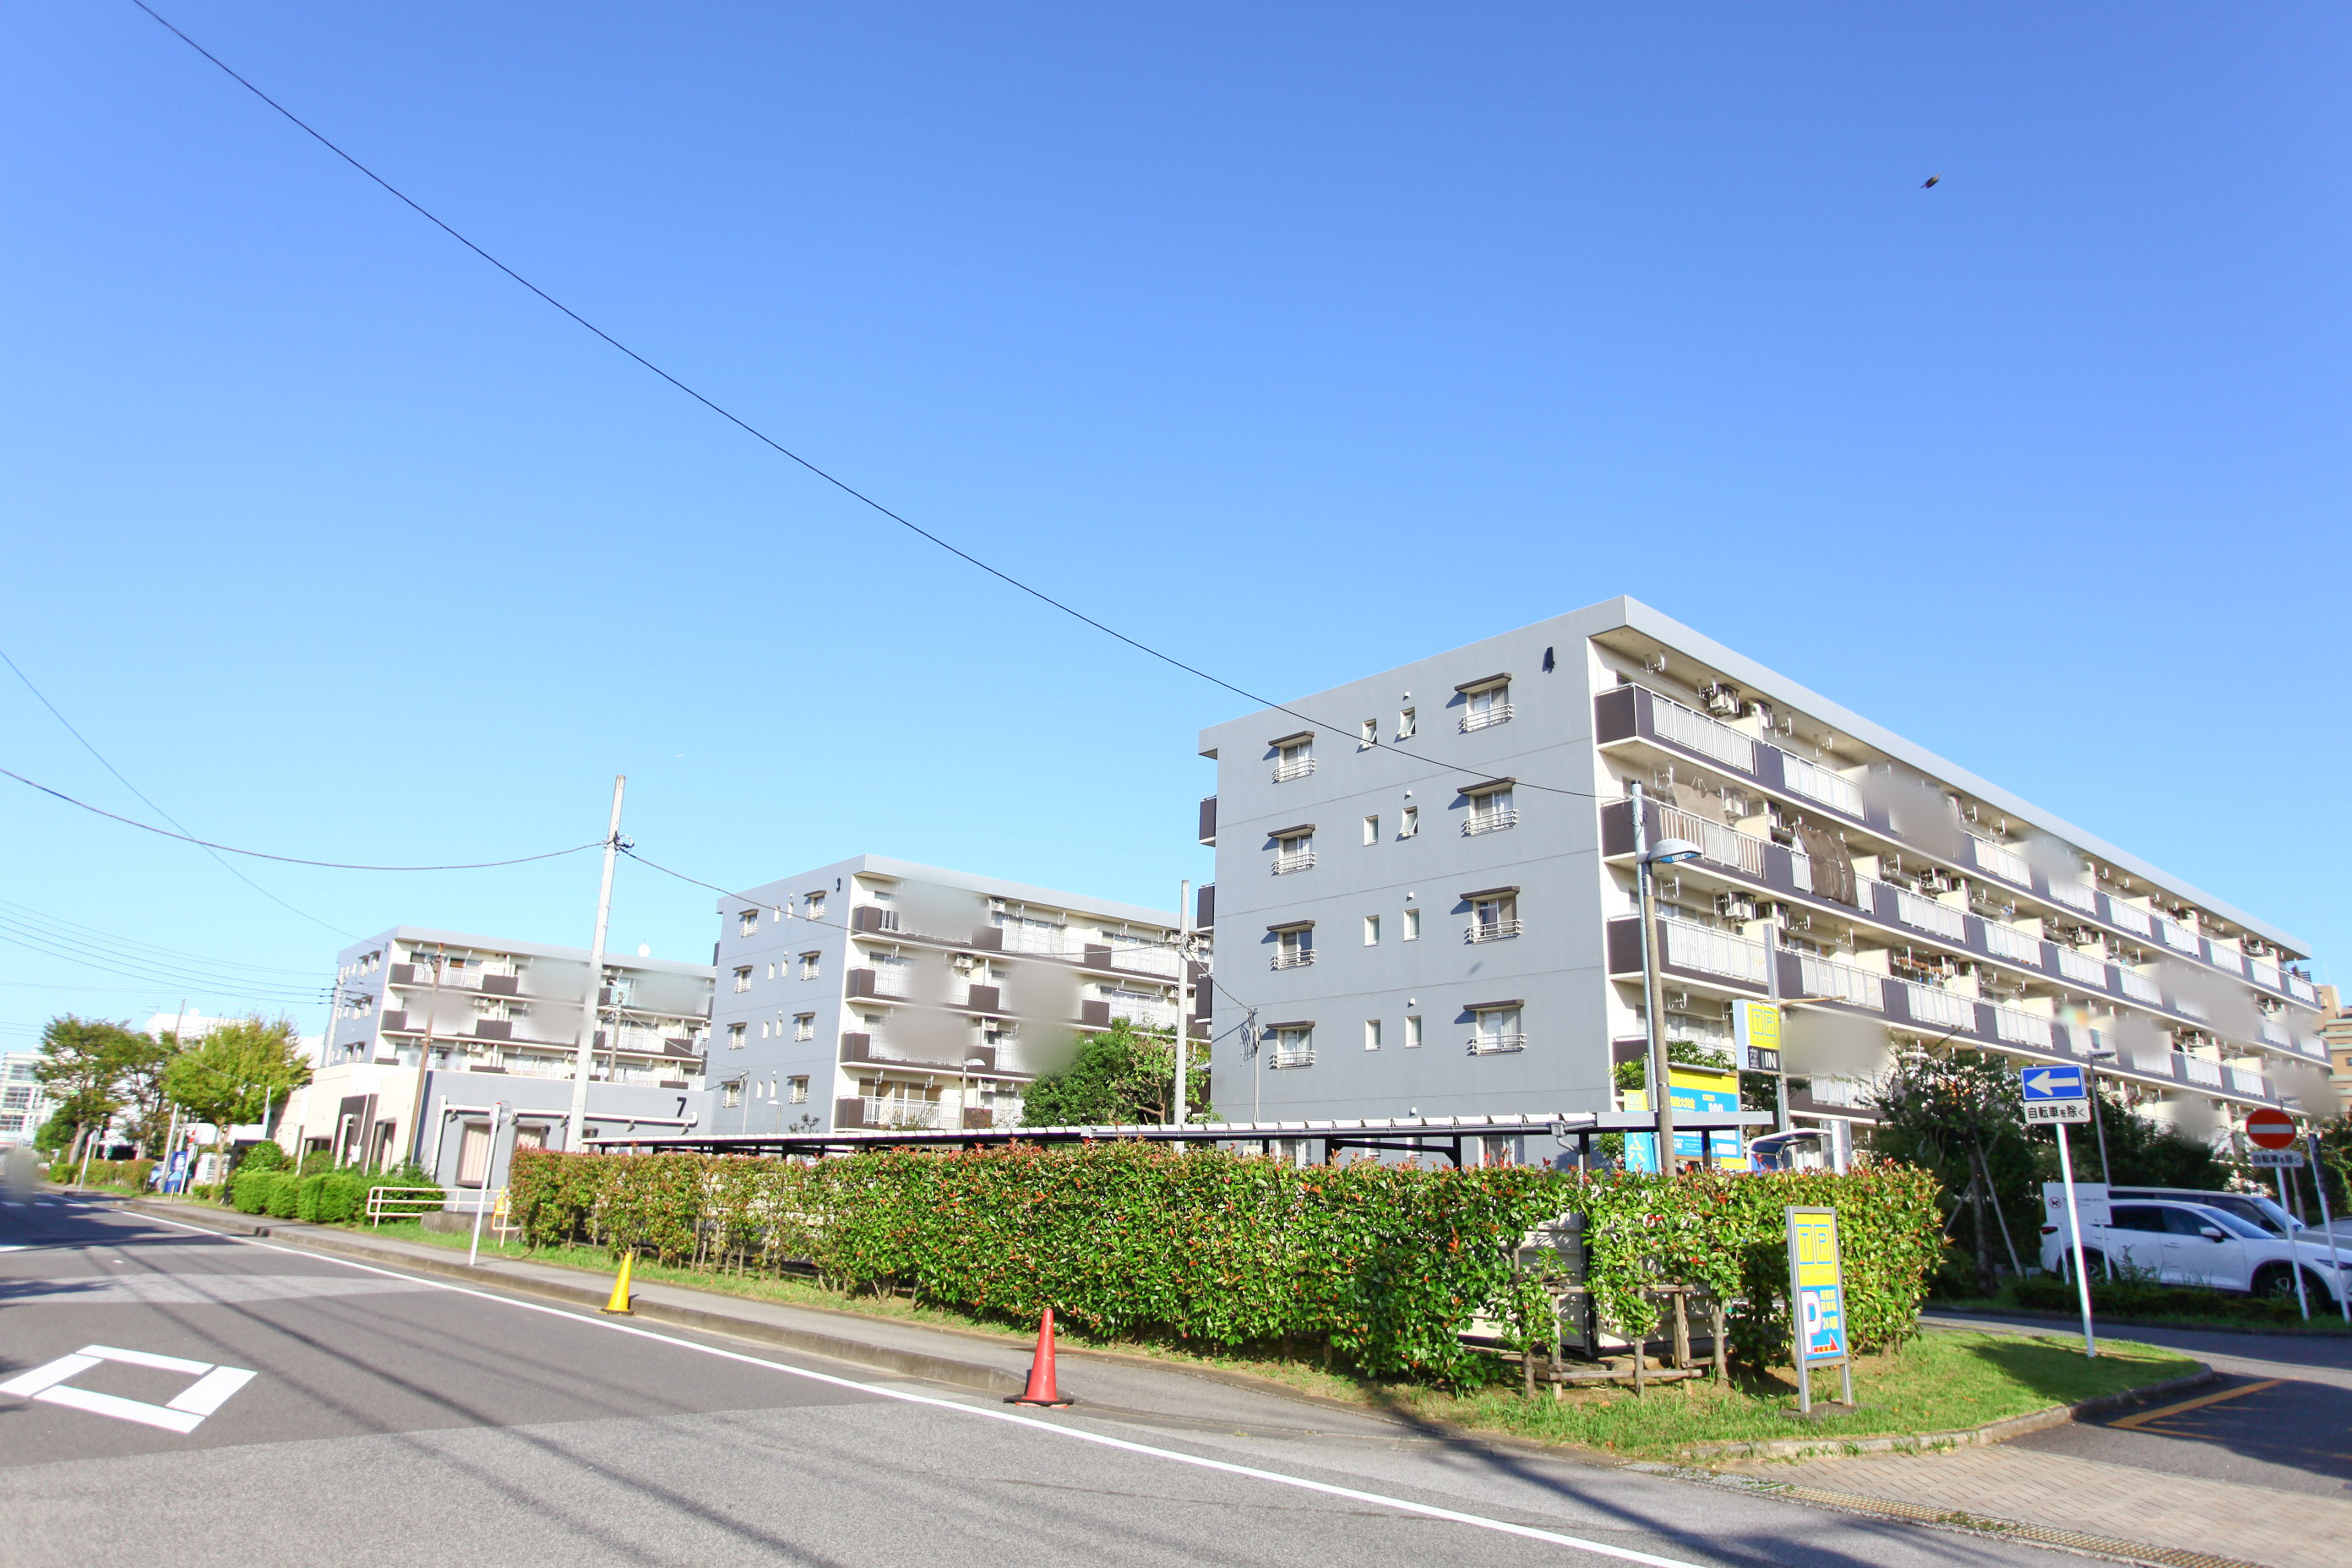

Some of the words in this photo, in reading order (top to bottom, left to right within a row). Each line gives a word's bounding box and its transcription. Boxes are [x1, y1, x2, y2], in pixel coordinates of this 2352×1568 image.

[1764, 1051, 1778, 1069] IN
[677, 1097, 687, 1118] 7
[2028, 1105, 2086, 1119] 自転車を除く
[2253, 1154, 2301, 1163] 自転車を除く
[1800, 1290, 1822, 1354] P
